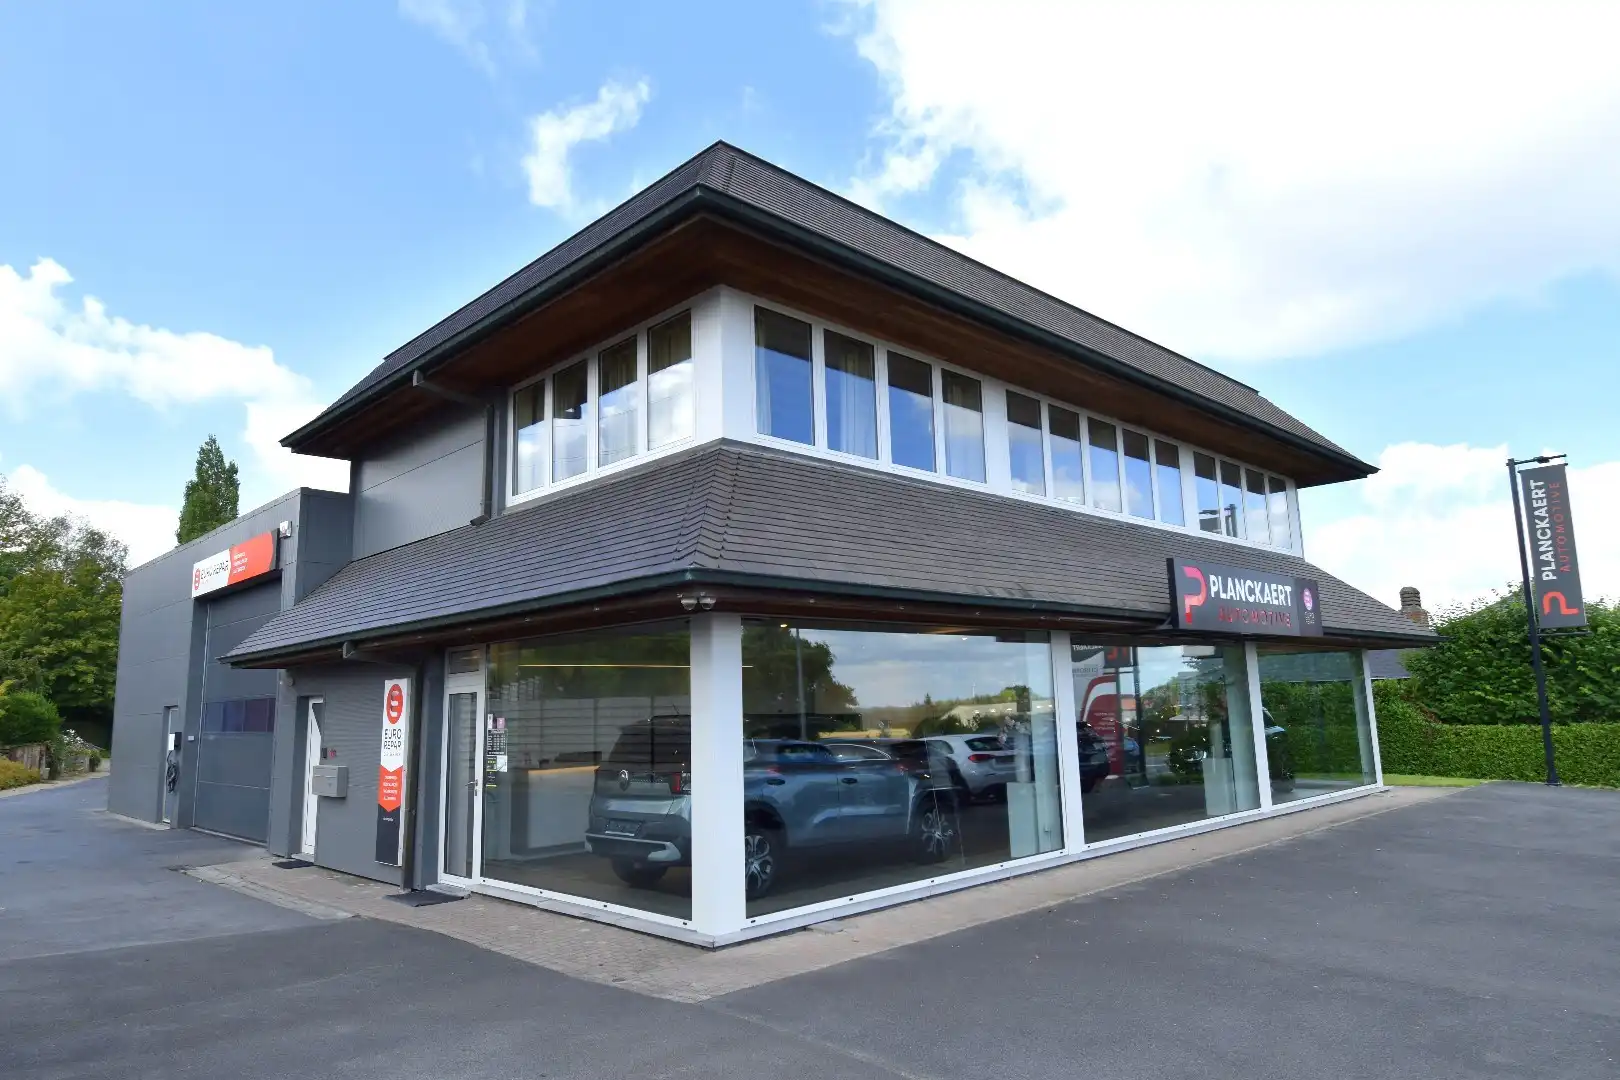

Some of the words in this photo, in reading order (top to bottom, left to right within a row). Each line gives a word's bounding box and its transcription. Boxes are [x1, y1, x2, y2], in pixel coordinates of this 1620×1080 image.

[1529, 479, 1558, 581] PLANCKAERT
[1549, 482, 1572, 573] AUTOMOTIVE
[1208, 574, 1292, 607] PLANCKAERT
[1217, 605, 1292, 629] AUTOMOTIVE
[384, 728, 402, 740] EURO
[384, 740, 402, 750] REPAR
